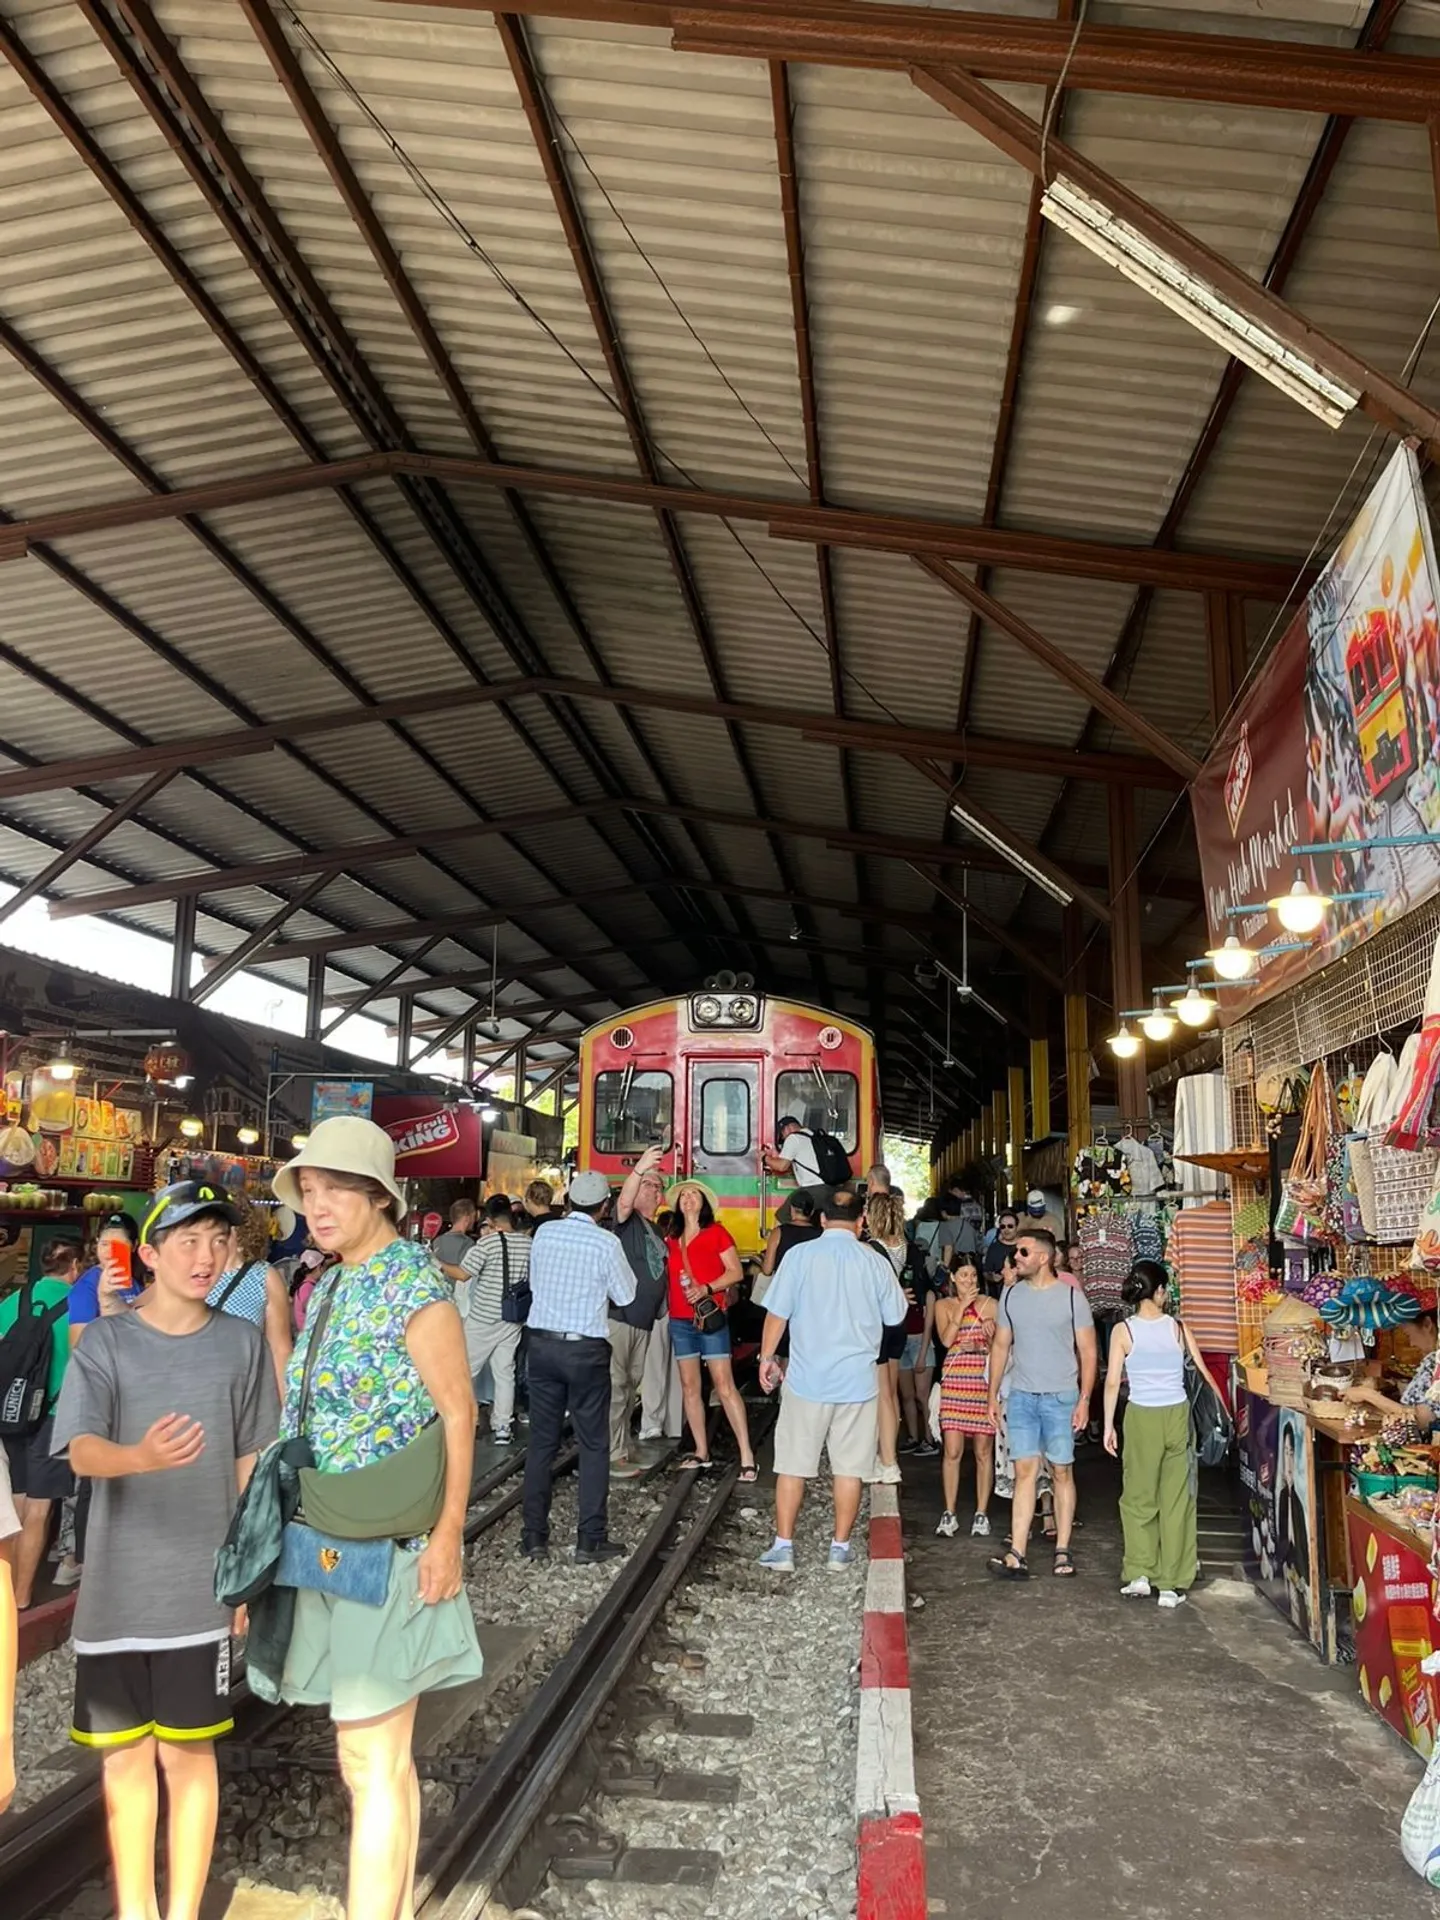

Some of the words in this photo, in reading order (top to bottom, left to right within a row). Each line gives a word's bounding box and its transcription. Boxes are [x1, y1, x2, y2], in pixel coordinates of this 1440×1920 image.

[1228, 841, 1251, 917] Hub
[1249, 787, 1299, 892] Market
[393, 1123, 452, 1156] KING
[415, 1114, 449, 1134] Fruit
[6, 1377, 24, 1422] MUNICH
